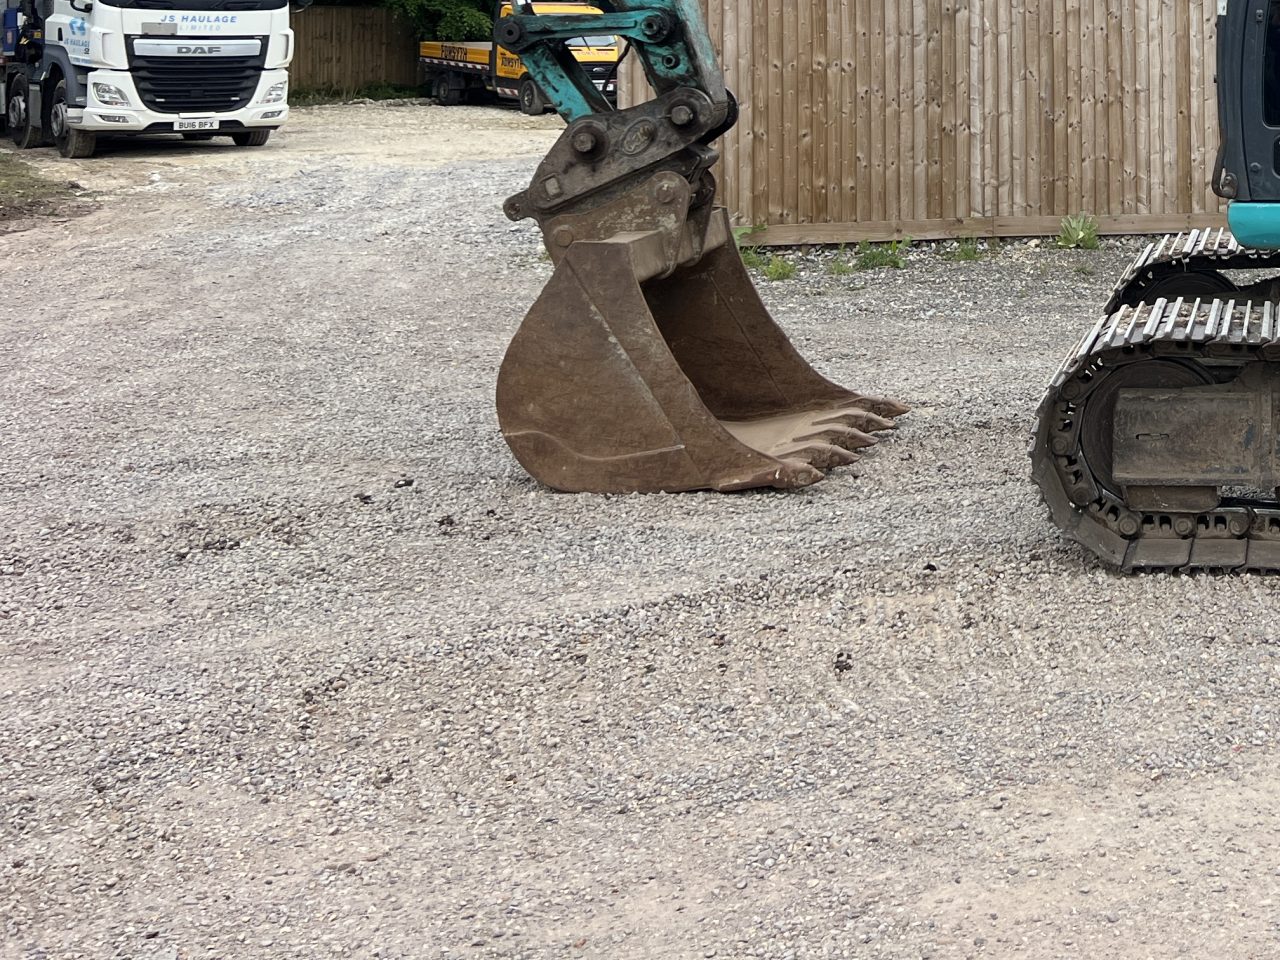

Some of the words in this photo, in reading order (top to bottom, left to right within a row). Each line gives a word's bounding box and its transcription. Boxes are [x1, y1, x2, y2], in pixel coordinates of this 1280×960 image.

[160, 15, 176, 23] JS
[181, 15, 238, 24] HAULAGE
[176, 46, 221, 55] DAF
[441, 44, 468, 61] FORSYTH
